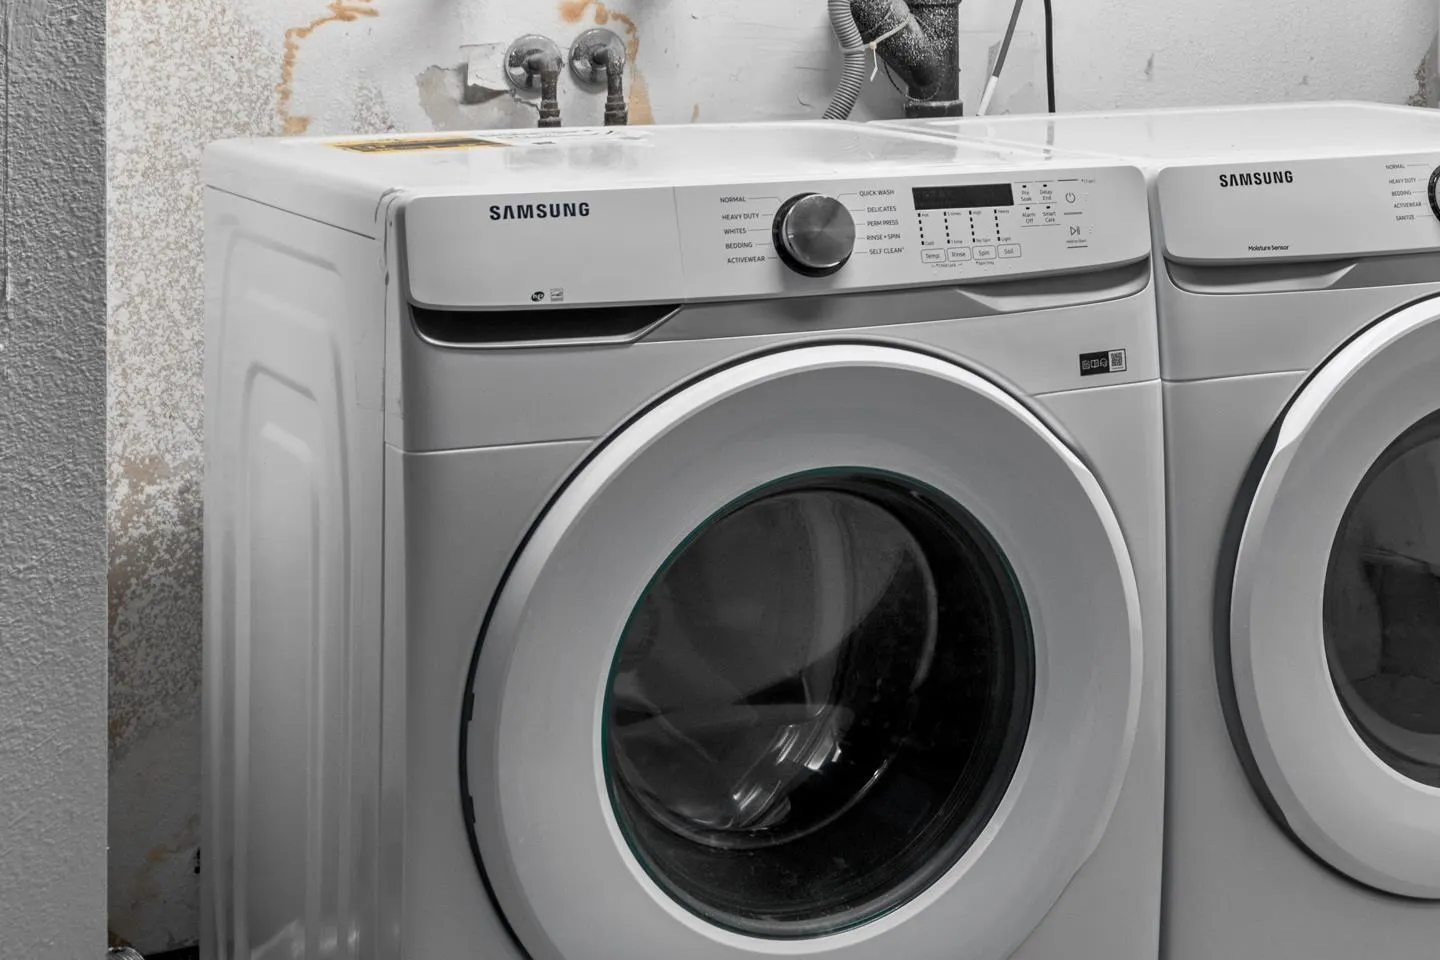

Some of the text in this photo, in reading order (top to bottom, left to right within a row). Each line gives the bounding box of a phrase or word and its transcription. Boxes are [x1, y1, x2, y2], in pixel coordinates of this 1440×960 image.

[1219, 170, 1294, 188] SAMSUNG
[719, 196, 747, 204] NORMAL
[489, 202, 591, 221] SAMSUNG
[722, 213, 742, 221] HEAVY
[725, 241, 753, 249] BEDDING
[727, 255, 766, 264] ACTIVEWEAR
